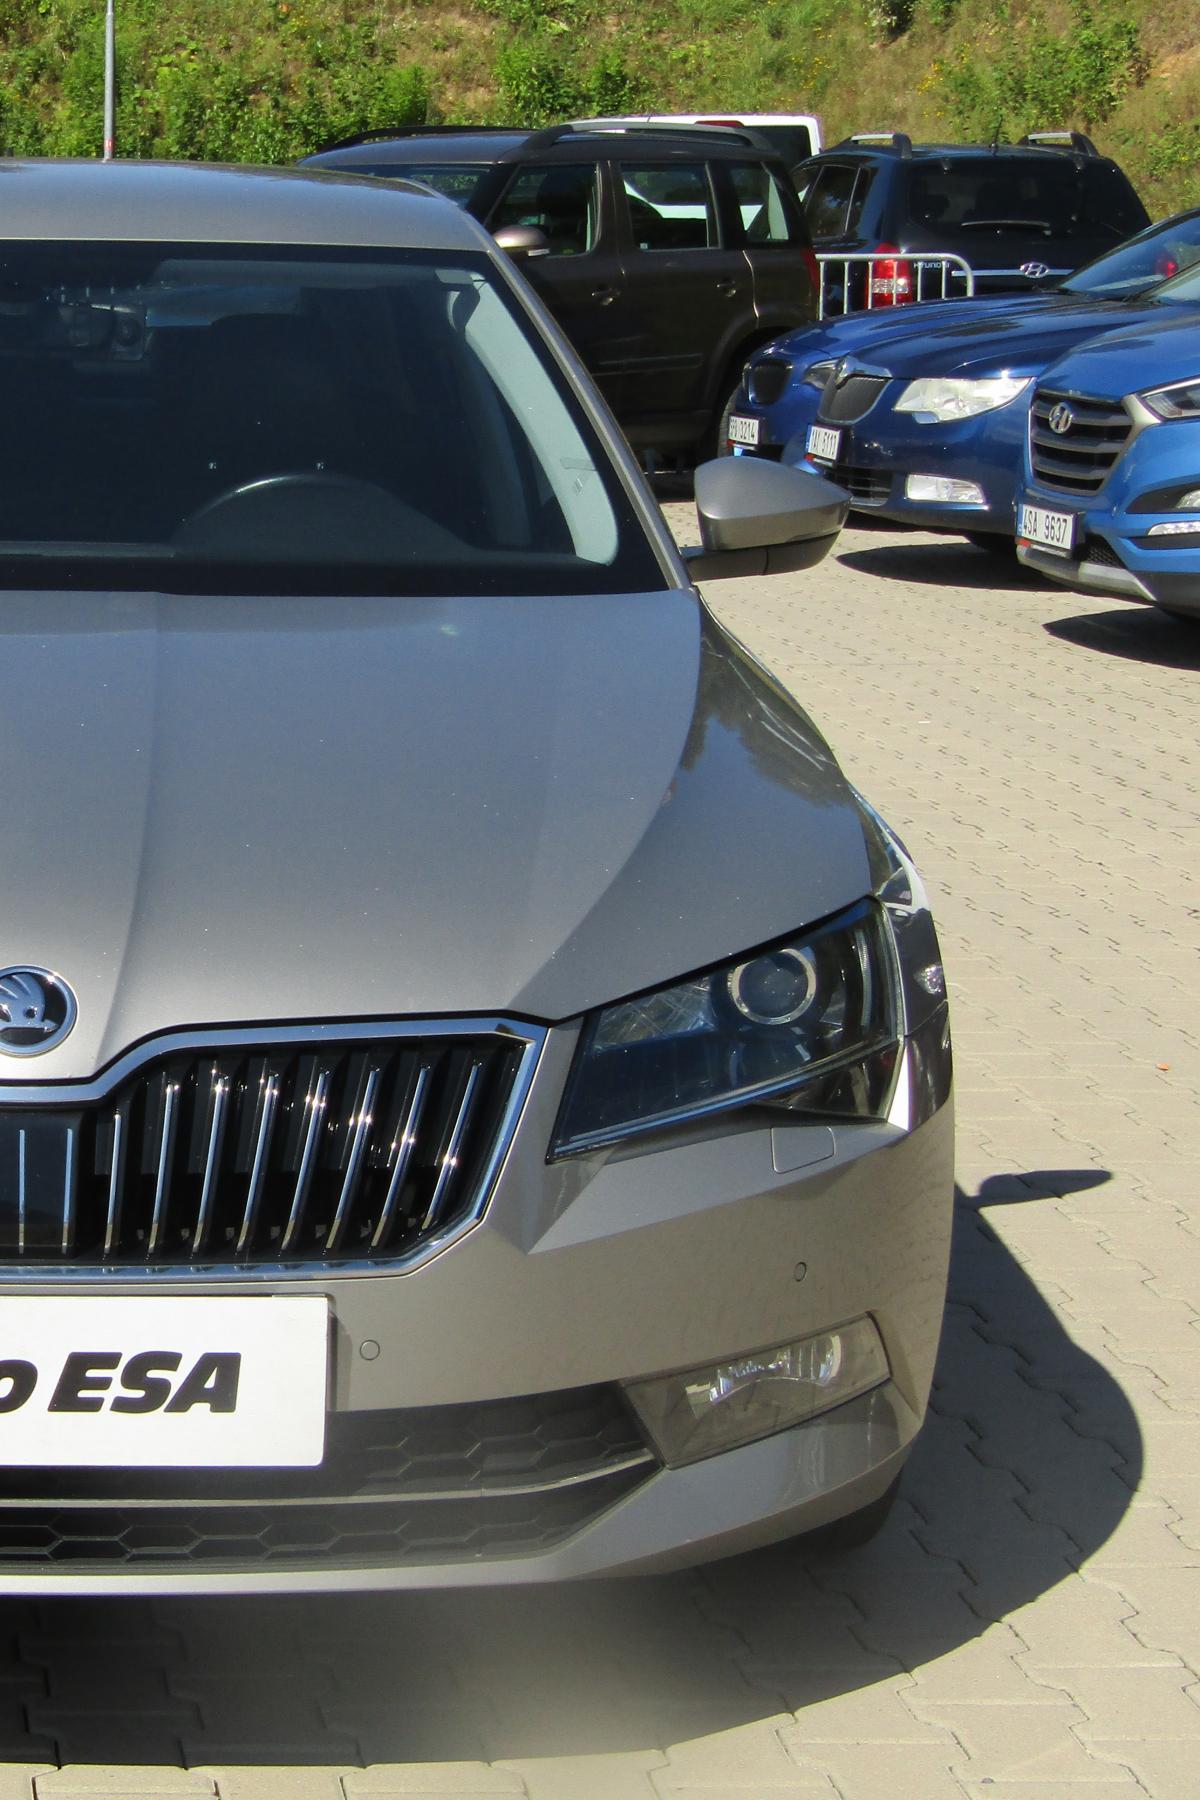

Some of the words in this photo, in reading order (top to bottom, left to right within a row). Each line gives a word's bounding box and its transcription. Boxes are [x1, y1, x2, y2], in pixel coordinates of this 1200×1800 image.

[913, 261, 950, 269] HYUNDI
[1023, 508, 1038, 536] 4SA
[1044, 513, 1068, 544] 9637
[47, 1351, 242, 1414] ESA
